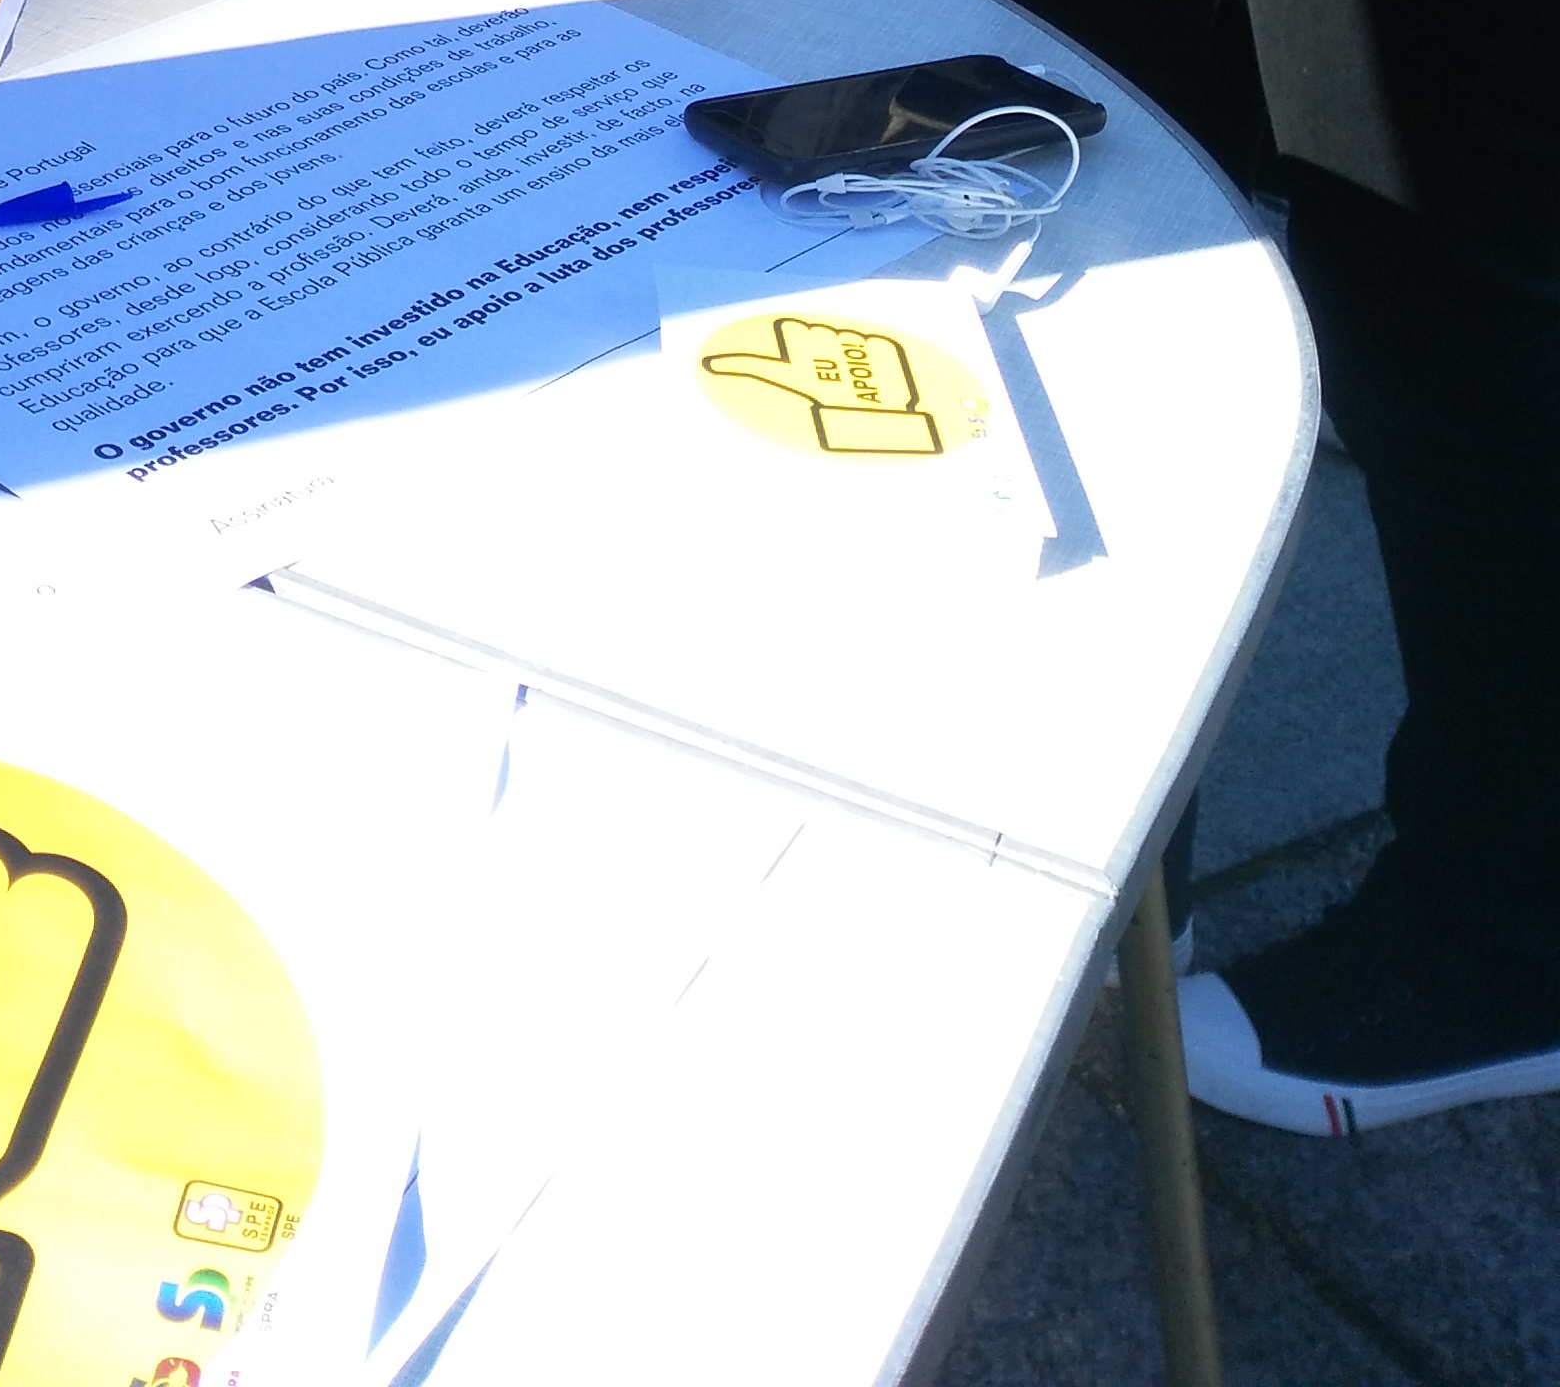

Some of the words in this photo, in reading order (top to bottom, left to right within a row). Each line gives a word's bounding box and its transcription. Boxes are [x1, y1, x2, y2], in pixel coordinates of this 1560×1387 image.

[5, 140, 97, 182] Portugal
[60, 153, 163, 196] ssenciais
[163, 131, 213, 158] para
[213, 125, 230, 133] o
[226, 102, 291, 128] futuro
[292, 90, 319, 103] do
[320, 72, 368, 95] país.
[364, 46, 426, 70] Como
[422, 33, 460, 47] tal,
[458, 8, 533, 37] deverão
[124, 198, 176, 225] para
[177, 190, 194, 200] o
[190, 165, 245, 191] bom
[241, 108, 387, 167] funcionamento
[388, 91, 426, 109] das
[426, 61, 498, 92] escolas
[499, 56, 515, 64] e
[514, 39, 557, 61] para
[556, 29, 582, 42] as
[149, 148, 228, 187] direitos
[232, 140, 249, 149] e
[253, 124, 292, 142] nas
[296, 102, 345, 125] suas
[348, 60, 444, 103] condições
[447, 49, 475, 61] de
[474, 20, 557, 50] trabalho,
[17, 363, 139, 414] Educação
[141, 339, 197, 368] para
[198, 319, 243, 343] que
[244, 309, 264, 320] a
[257, 276, 339, 311] Escola
[332, 236, 416, 277] Pública
[416, 203, 493, 241] garanta
[491, 188, 527, 205] um
[527, 157, 591, 190] ensino
[590, 145, 620, 158] da
[617, 126, 665, 147] mais
[33, 316, 51, 328] o
[58, 276, 161, 319] governo,
[163, 257, 193, 273] ao
[198, 211, 293, 258] contrário
[297, 195, 327, 210] do
[331, 178, 372, 197] que
[371, 158, 417, 179] tem
[414, 138, 474, 159] feito,
[474, 102, 541, 136] deverá
[541, 70, 621, 105] respeitar
[624, 59, 651, 73] os
[72, 249, 114, 270] das
[116, 210, 207, 250] crianças
[208, 201, 225, 211] e
[227, 180, 268, 202] dos
[264, 153, 343, 185] jovens.
[125, 283, 196, 316] desde
[194, 260, 260, 284] logo,
[263, 192, 399, 256] considerando
[400, 168, 452, 192] todo
[456, 159, 473, 168] o
[472, 129, 538, 160] tempo
[541, 116, 569, 129] de
[571, 88, 639, 117] serviço
[641, 71, 678, 89] que
[126, 290, 243, 342] exercendo
[247, 280, 267, 291] a
[267, 231, 373, 286] profissão.
[368, 193, 459, 229] Deverá,
[458, 168, 521, 194] ainda,
[515, 130, 597, 167] investir,
[596, 118, 624, 131] de
[619, 98, 681, 120] facto,
[678, 84, 707, 97] na
[94, 443, 124, 460] O
[129, 394, 242, 451] governo
[244, 372, 297, 397] não
[294, 346, 351, 373] tem
[344, 289, 465, 349] investido
[465, 272, 501, 290] na
[493, 221, 622, 274] Educação,
[618, 192, 670, 219] nem
[668, 156, 740, 194] respei
[126, 403, 300, 483] professores.
[294, 375, 349, 402] Por
[346, 350, 419, 379] isso,
[417, 326, 453, 347] eu
[453, 291, 523, 329] apoio
[523, 282, 545, 293] a
[536, 259, 593, 284] luta
[592, 238, 638, 261] dos
[813, 358, 842, 383] EU
[841, 343, 882, 404] APOIO!
[52, 381, 174, 433] qualidade.
[242, 1201, 269, 1240] SPE
[282, 1213, 301, 1240] SPE
